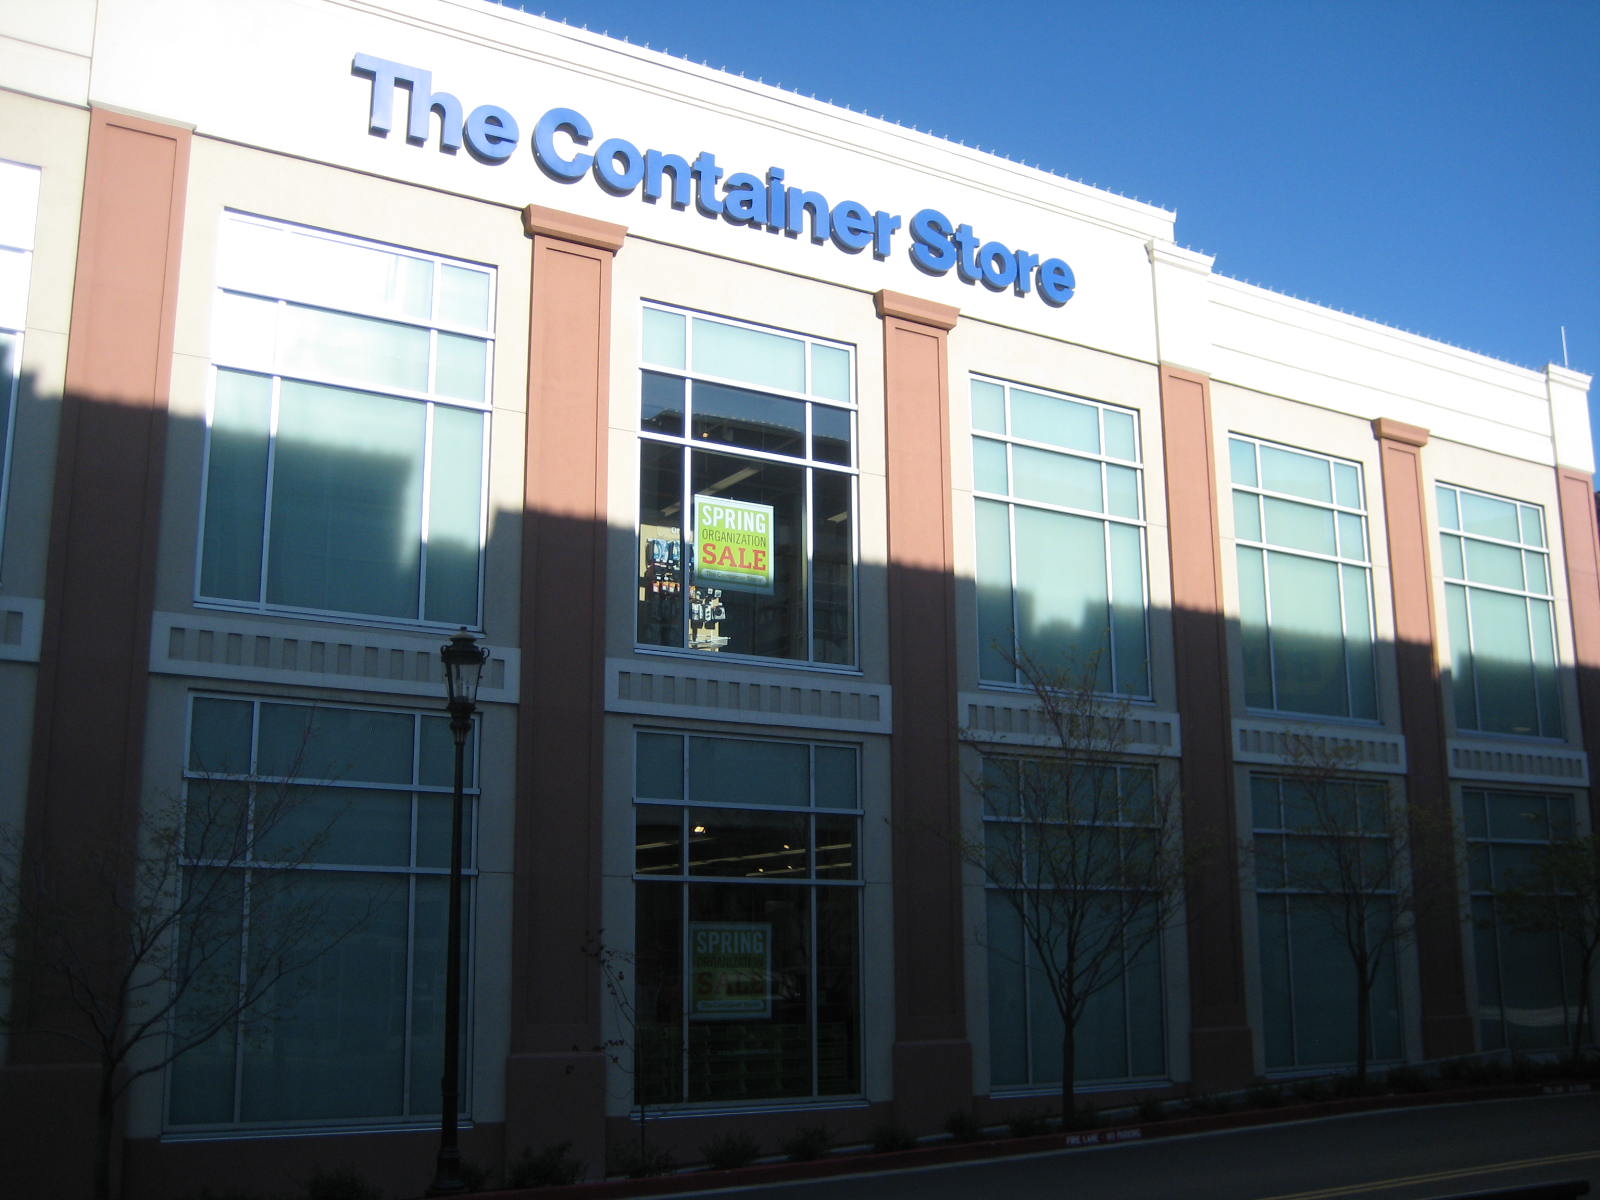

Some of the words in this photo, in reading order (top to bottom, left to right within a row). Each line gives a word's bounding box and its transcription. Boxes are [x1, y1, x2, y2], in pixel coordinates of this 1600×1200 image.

[351, 52, 520, 166] The
[531, 107, 901, 262] Container
[908, 208, 1076, 308] Store
[702, 505, 766, 534] SPRING
[702, 528, 767, 548] ORGANIZATION
[702, 543, 766, 571] SALE
[697, 931, 764, 955] SPRING
